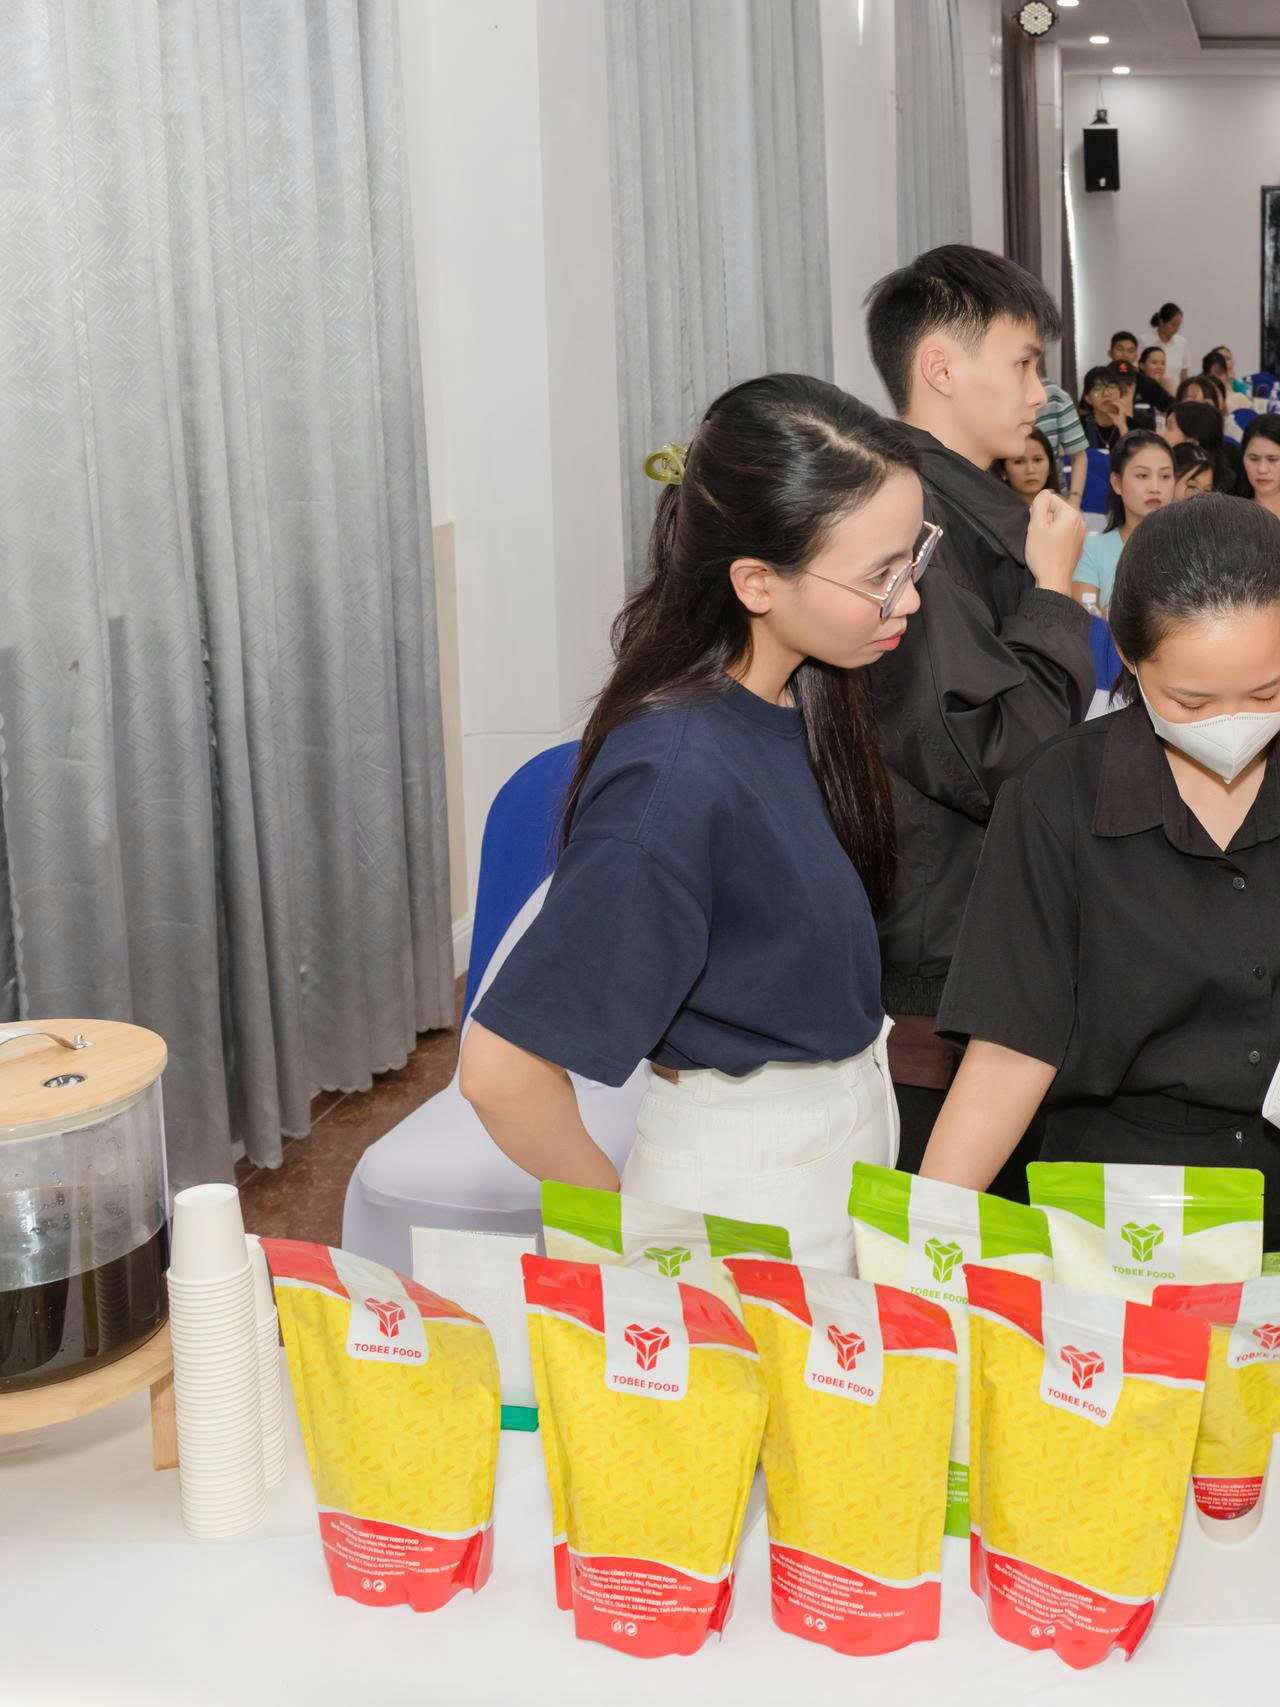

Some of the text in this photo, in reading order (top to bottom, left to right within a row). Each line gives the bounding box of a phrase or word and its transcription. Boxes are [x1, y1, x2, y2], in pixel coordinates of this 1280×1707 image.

[1146, 1270, 1176, 1279] FOOD
[354, 1343, 422, 1359] TOBEE FOOD
[612, 1375, 680, 1392] TOBEE FOOD
[811, 1373, 874, 1397] TOBEE FOOD
[1048, 1387, 1107, 1418] TOBEE FOOD
